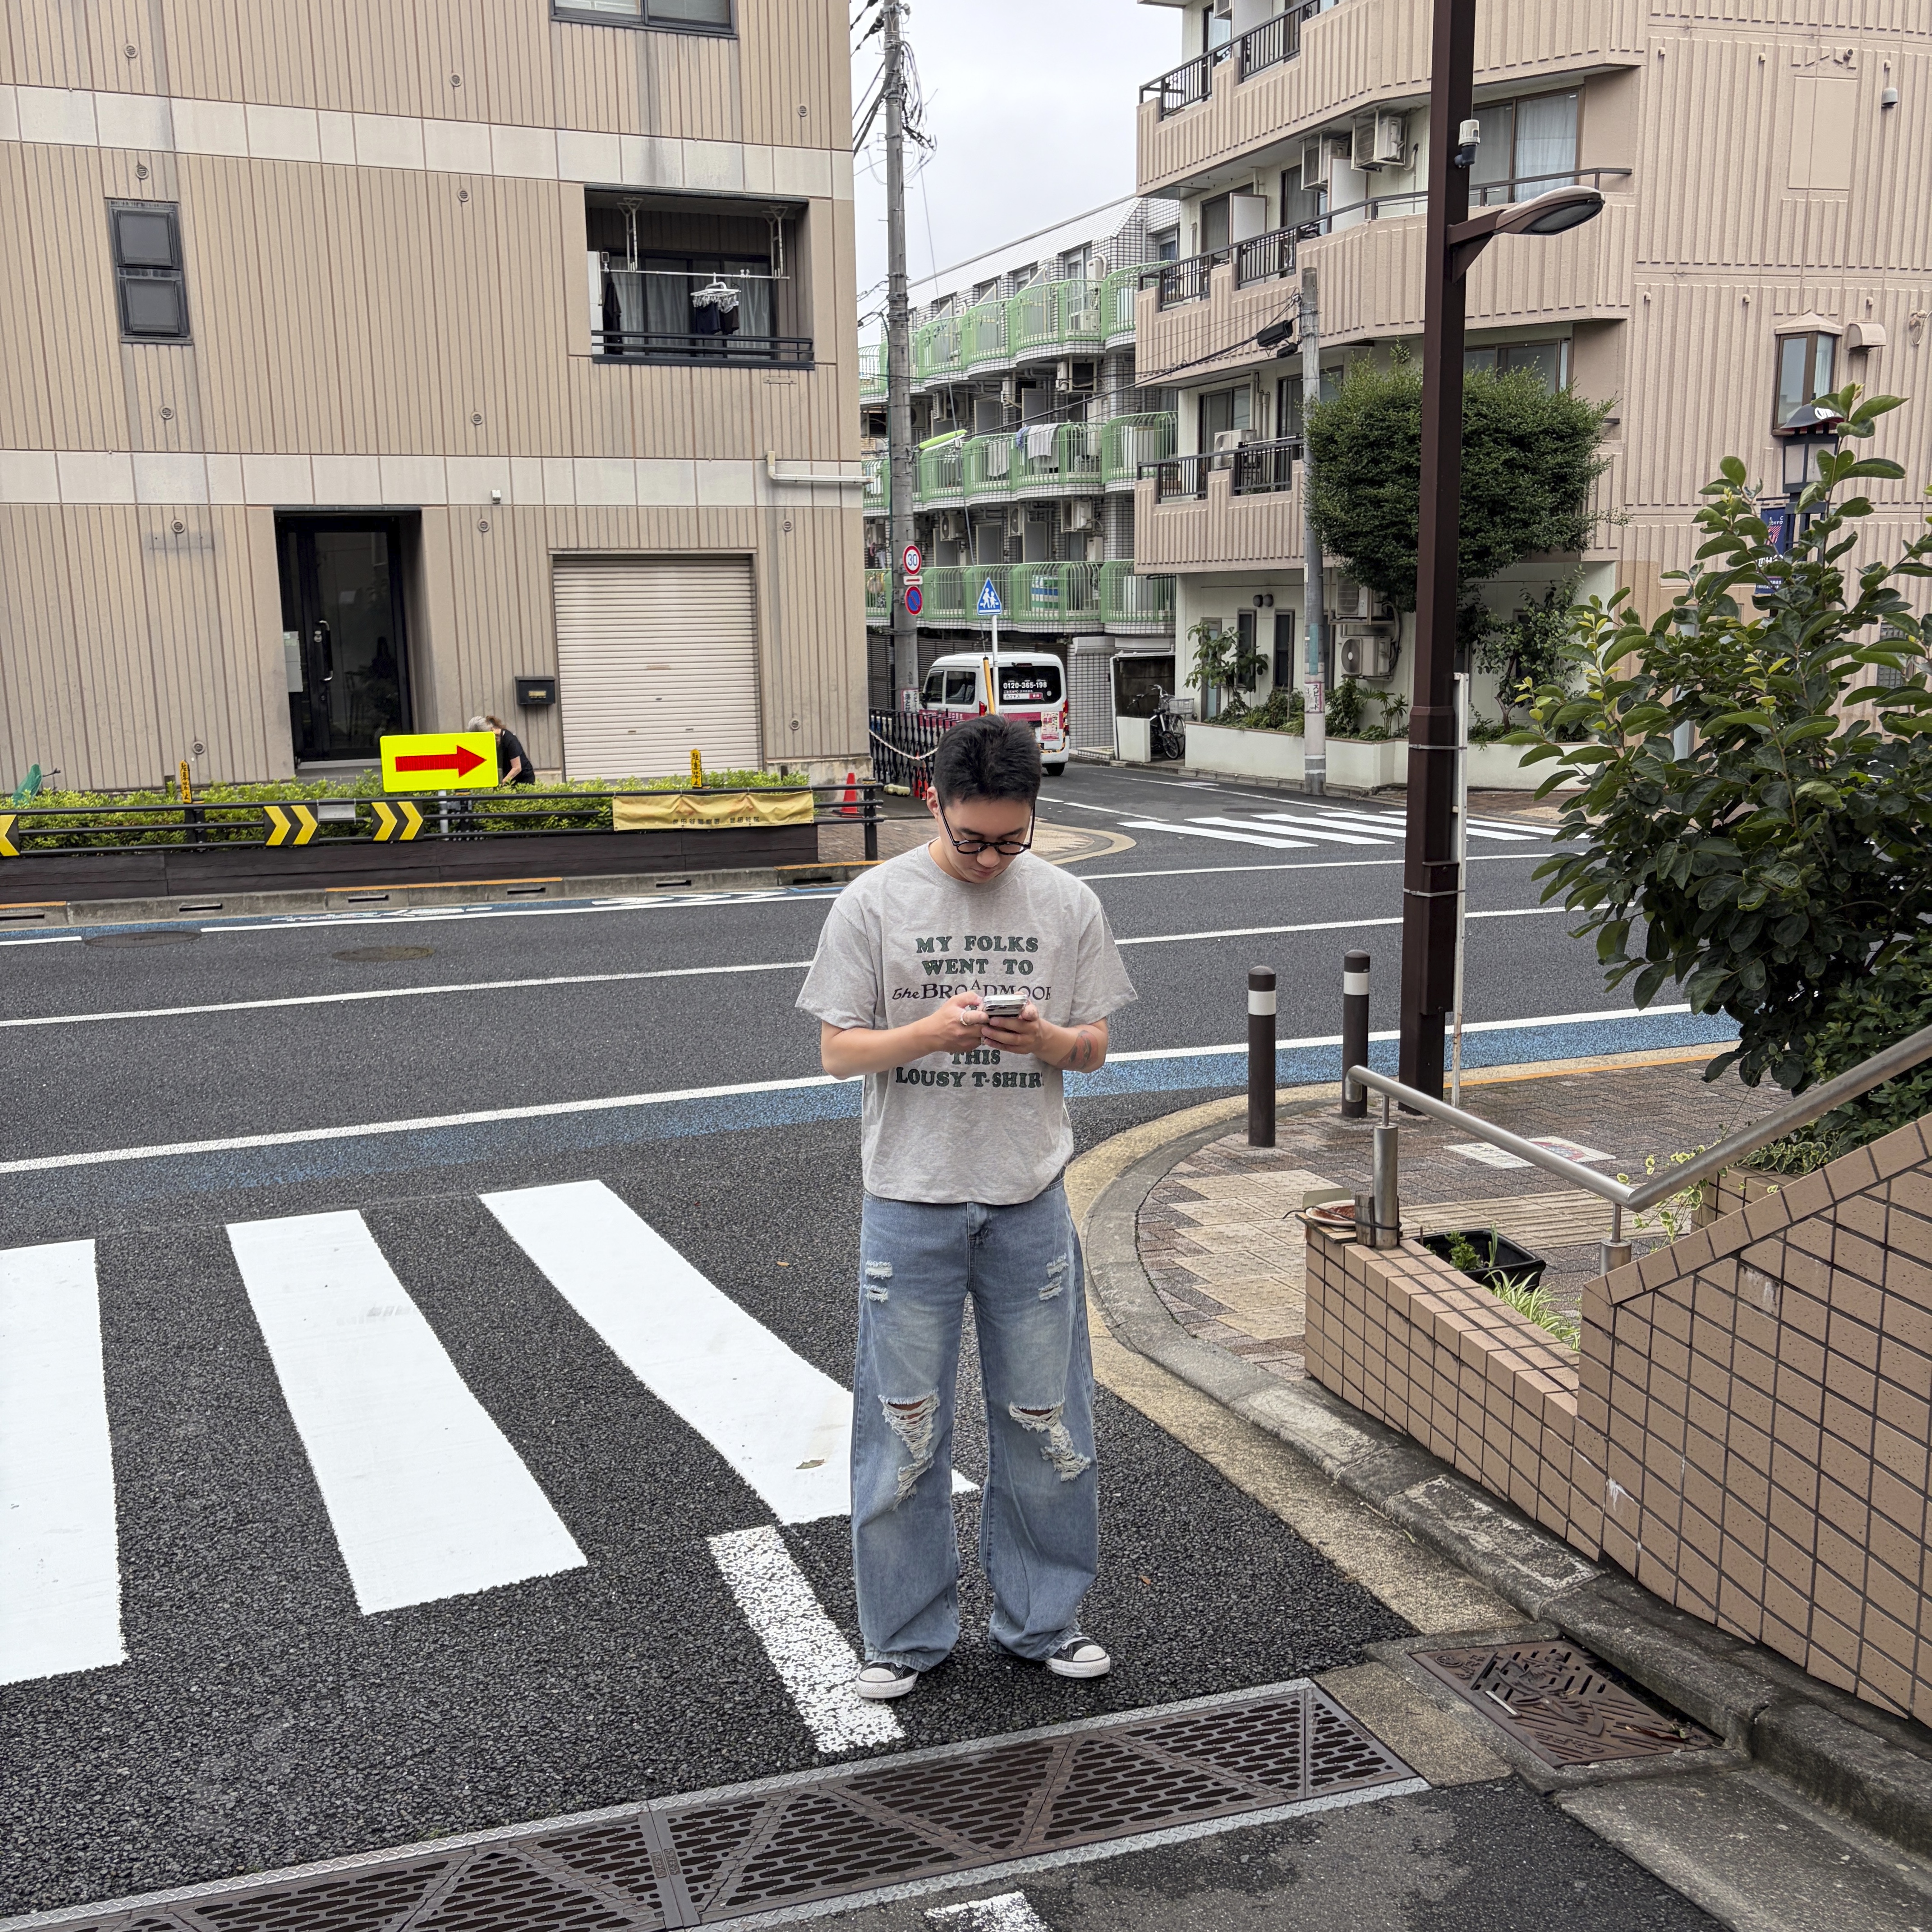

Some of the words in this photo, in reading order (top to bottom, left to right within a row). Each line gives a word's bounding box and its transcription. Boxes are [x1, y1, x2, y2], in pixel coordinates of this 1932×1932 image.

[908, 553, 918, 566] 30
[915, 936, 952, 953] MY
[964, 935, 1038, 952] FOLKS
[922, 958, 989, 975] WENT
[1003, 959, 1034, 975] TO
[950, 1049, 1001, 1065] THIS
[896, 1067, 966, 1087] LOUSY
[972, 1072, 1044, 1088] T-SHIR
